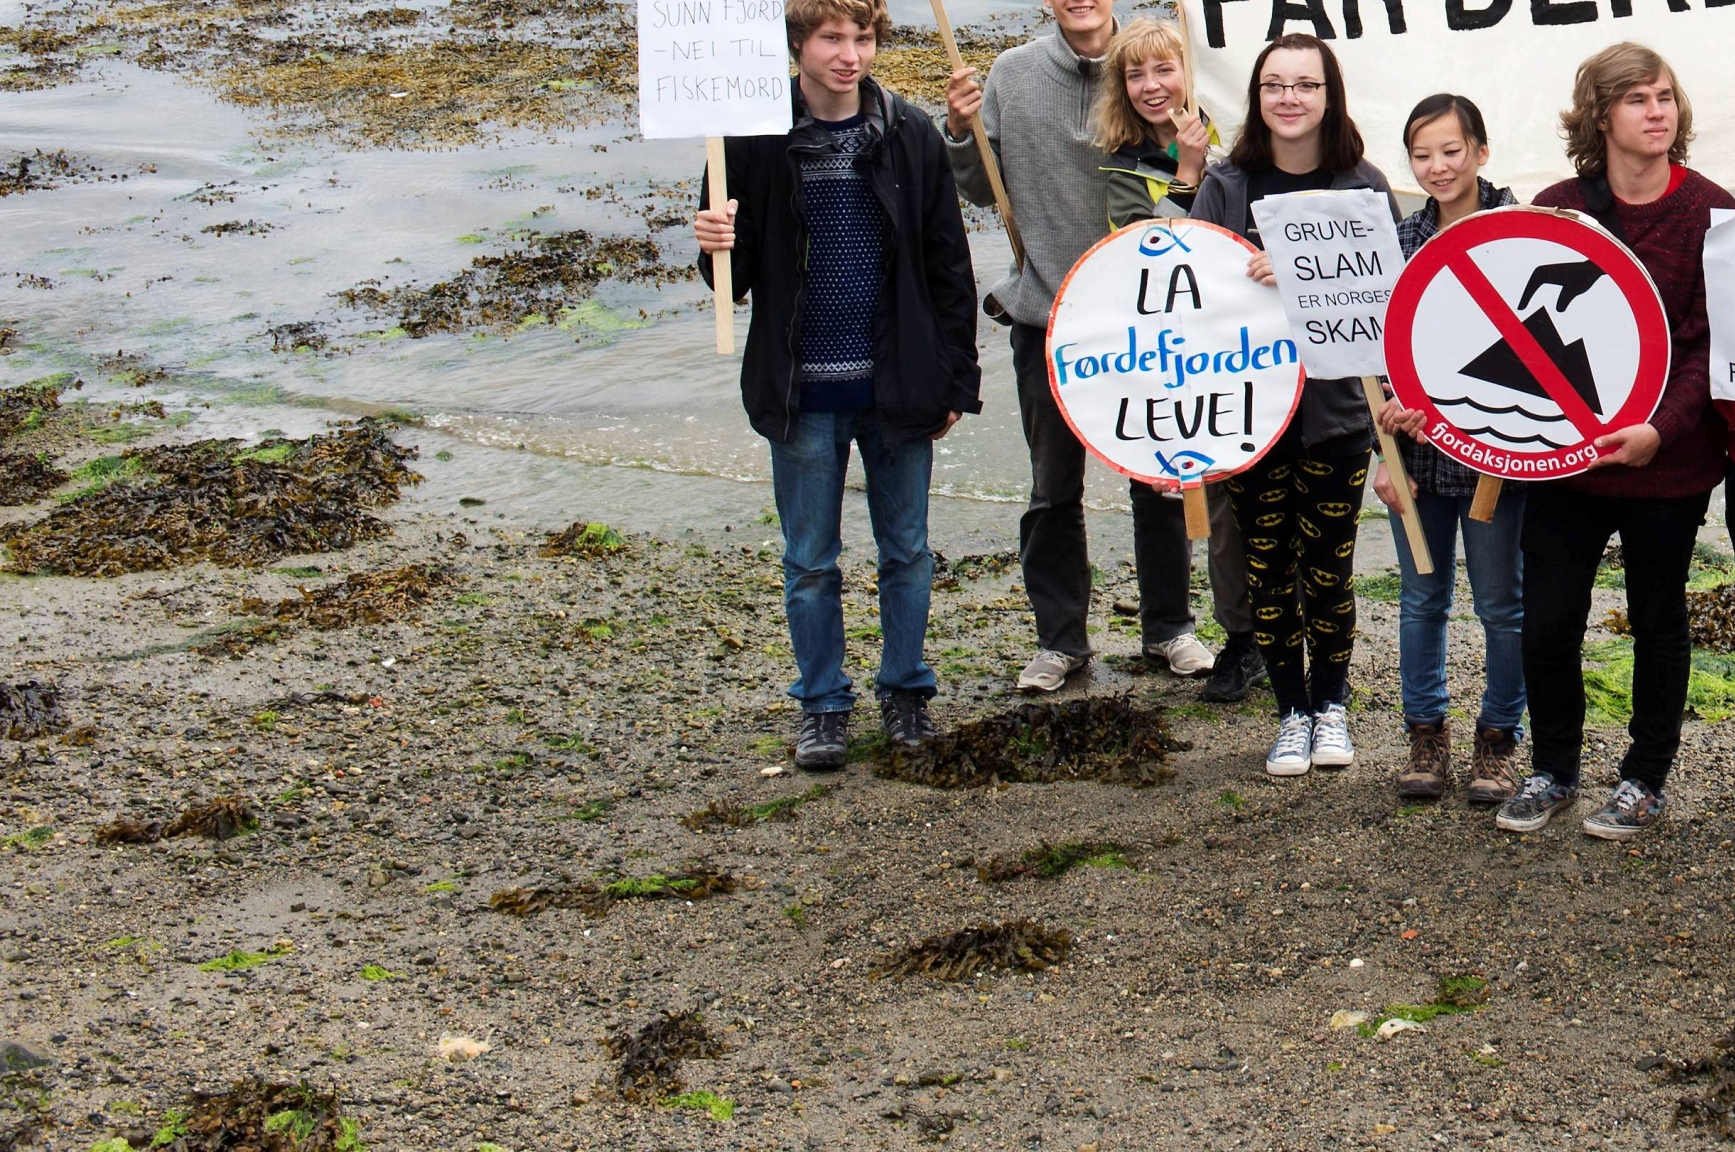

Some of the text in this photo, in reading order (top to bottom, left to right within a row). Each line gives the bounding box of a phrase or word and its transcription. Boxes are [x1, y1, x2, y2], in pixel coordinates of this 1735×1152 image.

[653, 0, 783, 28] SUNN FJORD
[730, 38, 776, 57] TIL
[657, 75, 783, 102] FISKEMORD
[1284, 220, 1375, 242] GRUVE-
[1294, 251, 1383, 281] SLAM
[1136, 264, 1202, 315] LA
[1298, 295, 1321, 309] ER
[1115, 381, 1256, 453] LEVE!
[1431, 423, 1598, 473] fjordaksjonen.org
